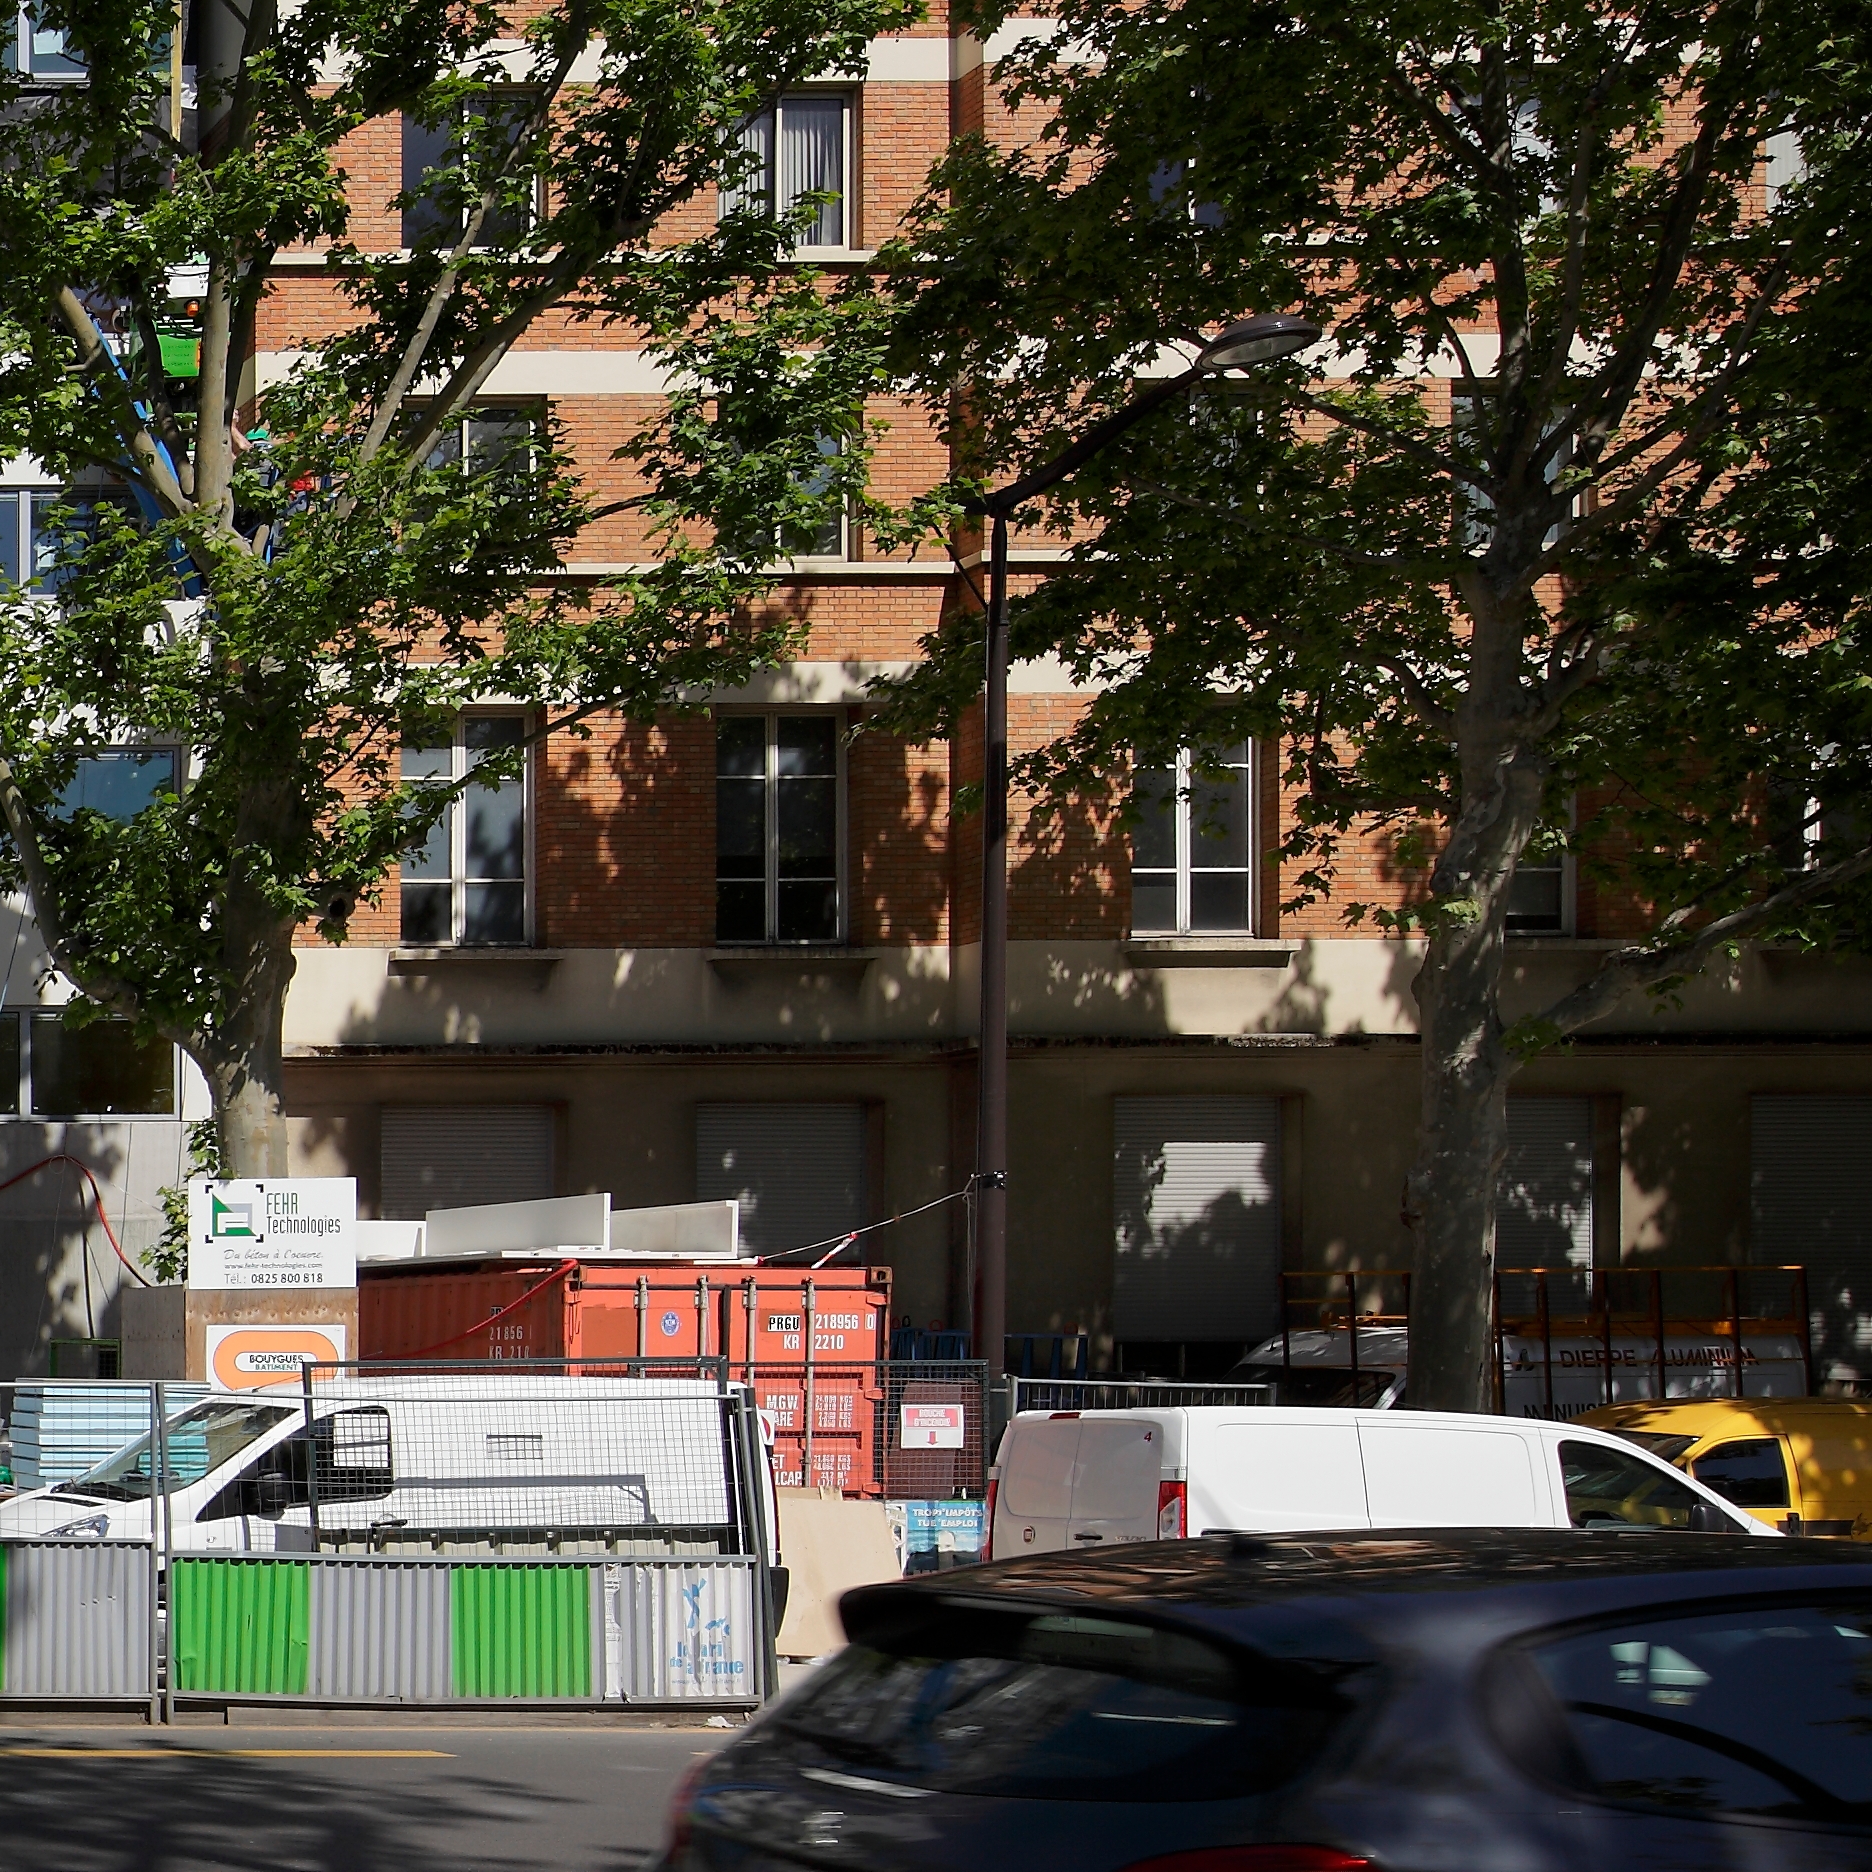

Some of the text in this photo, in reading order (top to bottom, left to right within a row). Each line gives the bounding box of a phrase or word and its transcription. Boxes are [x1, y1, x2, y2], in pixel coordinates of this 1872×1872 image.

[266, 1192, 298, 1215] FEHR
[266, 1215, 342, 1237] Technologies
[251, 1273, 277, 1284] 0825
[281, 1273, 300, 1283] 800
[303, 1273, 323, 1283] 818
[769, 1317, 800, 1330] PRGU
[815, 1314, 859, 1330] 218956
[783, 1334, 844, 1350] KR 2210
[249, 1354, 304, 1364] BOUYGUES
[1559, 1347, 1760, 1368] DIEPPE ALUMINIUM
[766, 1394, 799, 1410] M.G.W.
[773, 1411, 794, 1427] ARE
[1144, 1432, 1152, 1442] 4
